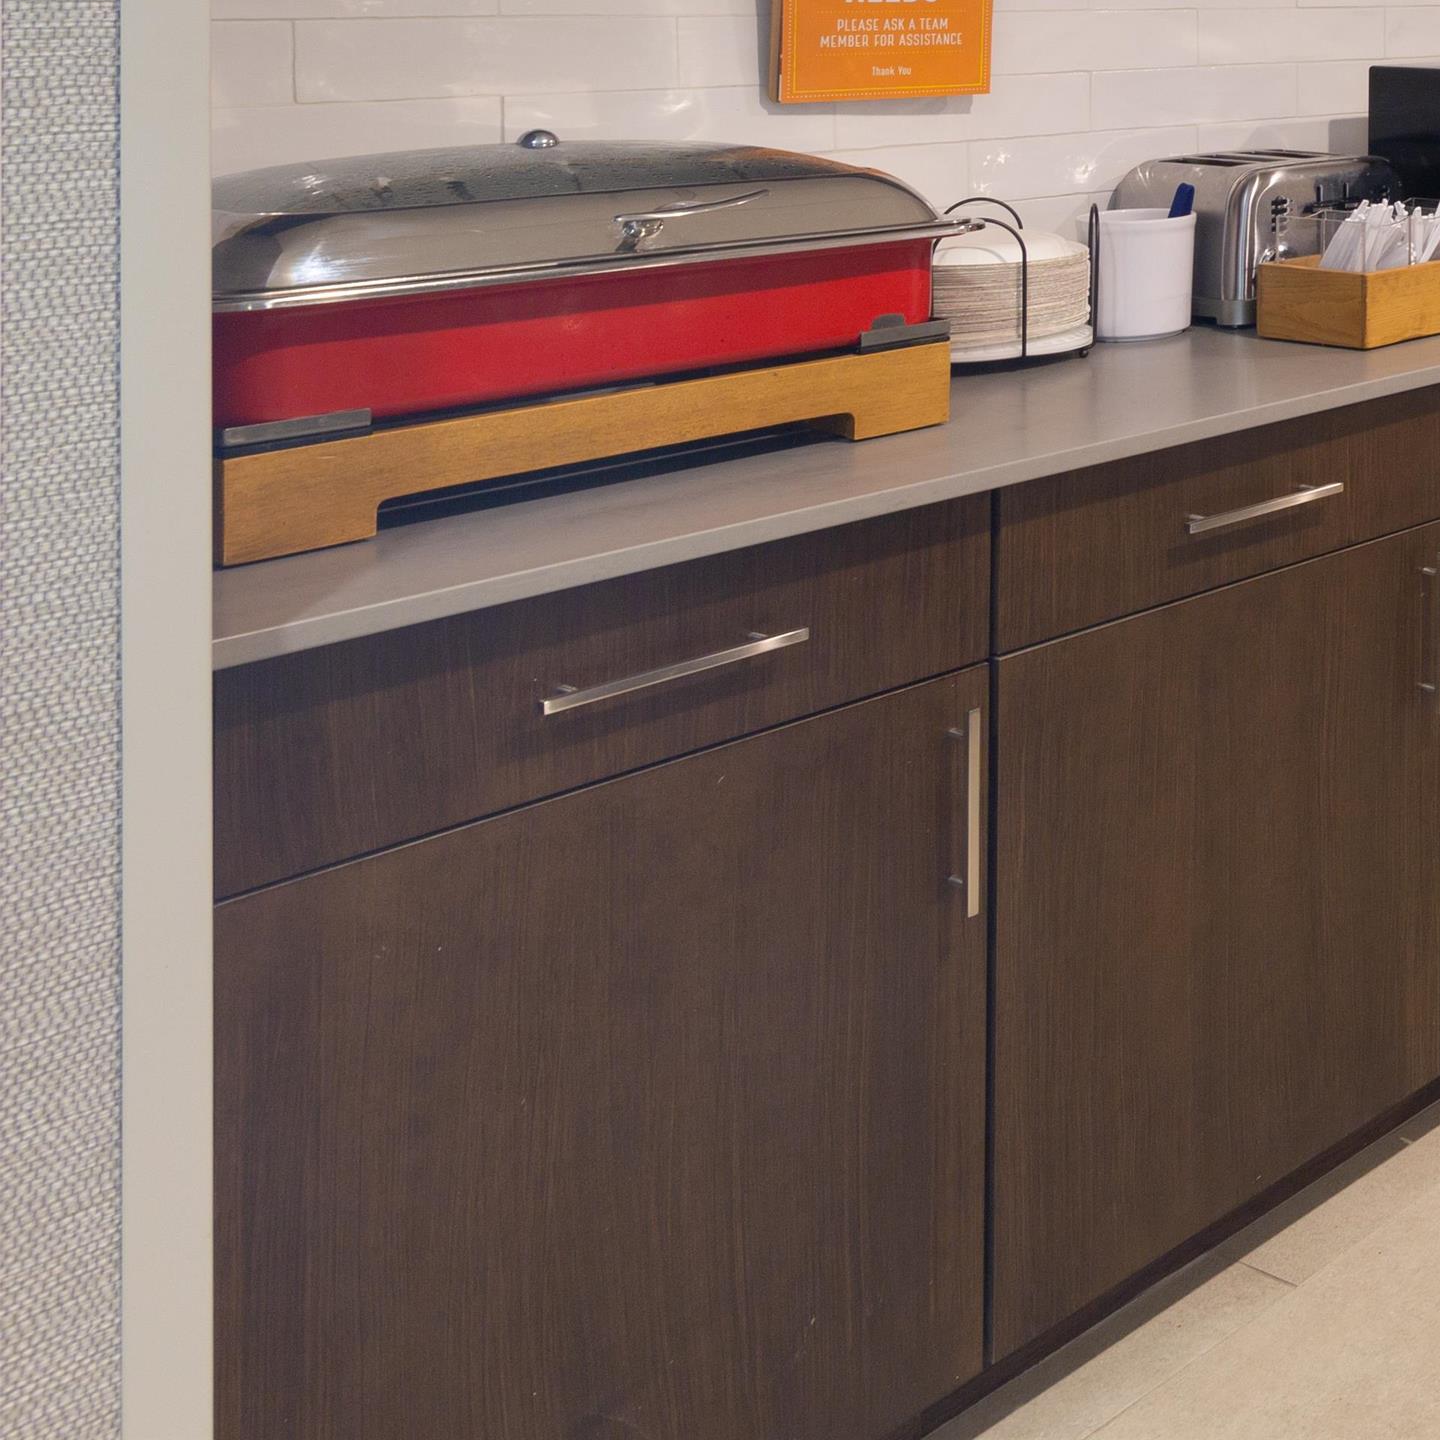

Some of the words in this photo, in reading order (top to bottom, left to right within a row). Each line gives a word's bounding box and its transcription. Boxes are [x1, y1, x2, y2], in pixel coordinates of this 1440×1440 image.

[837, 18, 879, 32] PLEASE
[883, 18, 905, 32] ASK
[908, 18, 917, 31] A
[920, 17, 948, 31] TEAM
[820, 35, 869, 48] MEMBER
[874, 34, 895, 47] FOR
[898, 33, 962, 47] ASSISTANCE
[871, 66, 895, 76] Thank
[897, 66, 912, 76] You
